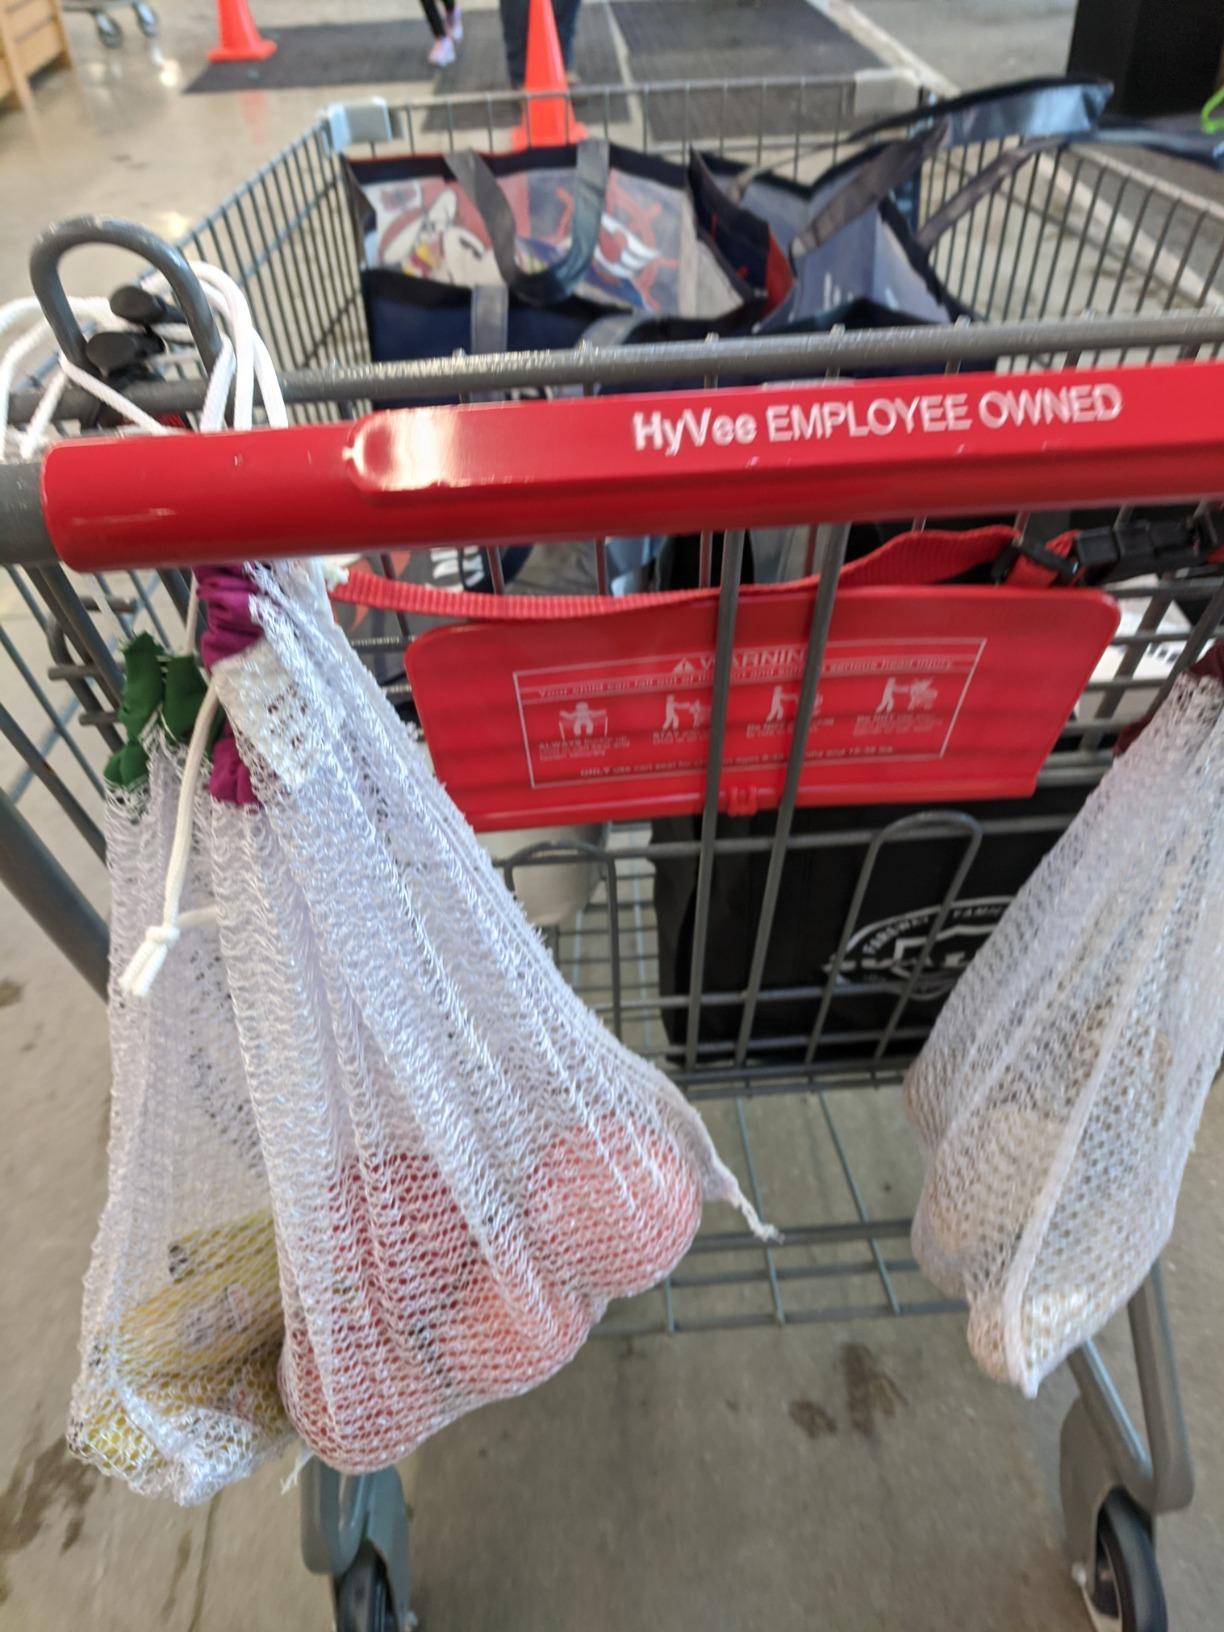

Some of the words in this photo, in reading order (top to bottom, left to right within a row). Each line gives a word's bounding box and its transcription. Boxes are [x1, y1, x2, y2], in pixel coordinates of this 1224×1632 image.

[766, 394, 972, 442] EMPLOYEE
[979, 383, 1123, 429] OWNED
[701, 647, 806, 671] WRNIN
